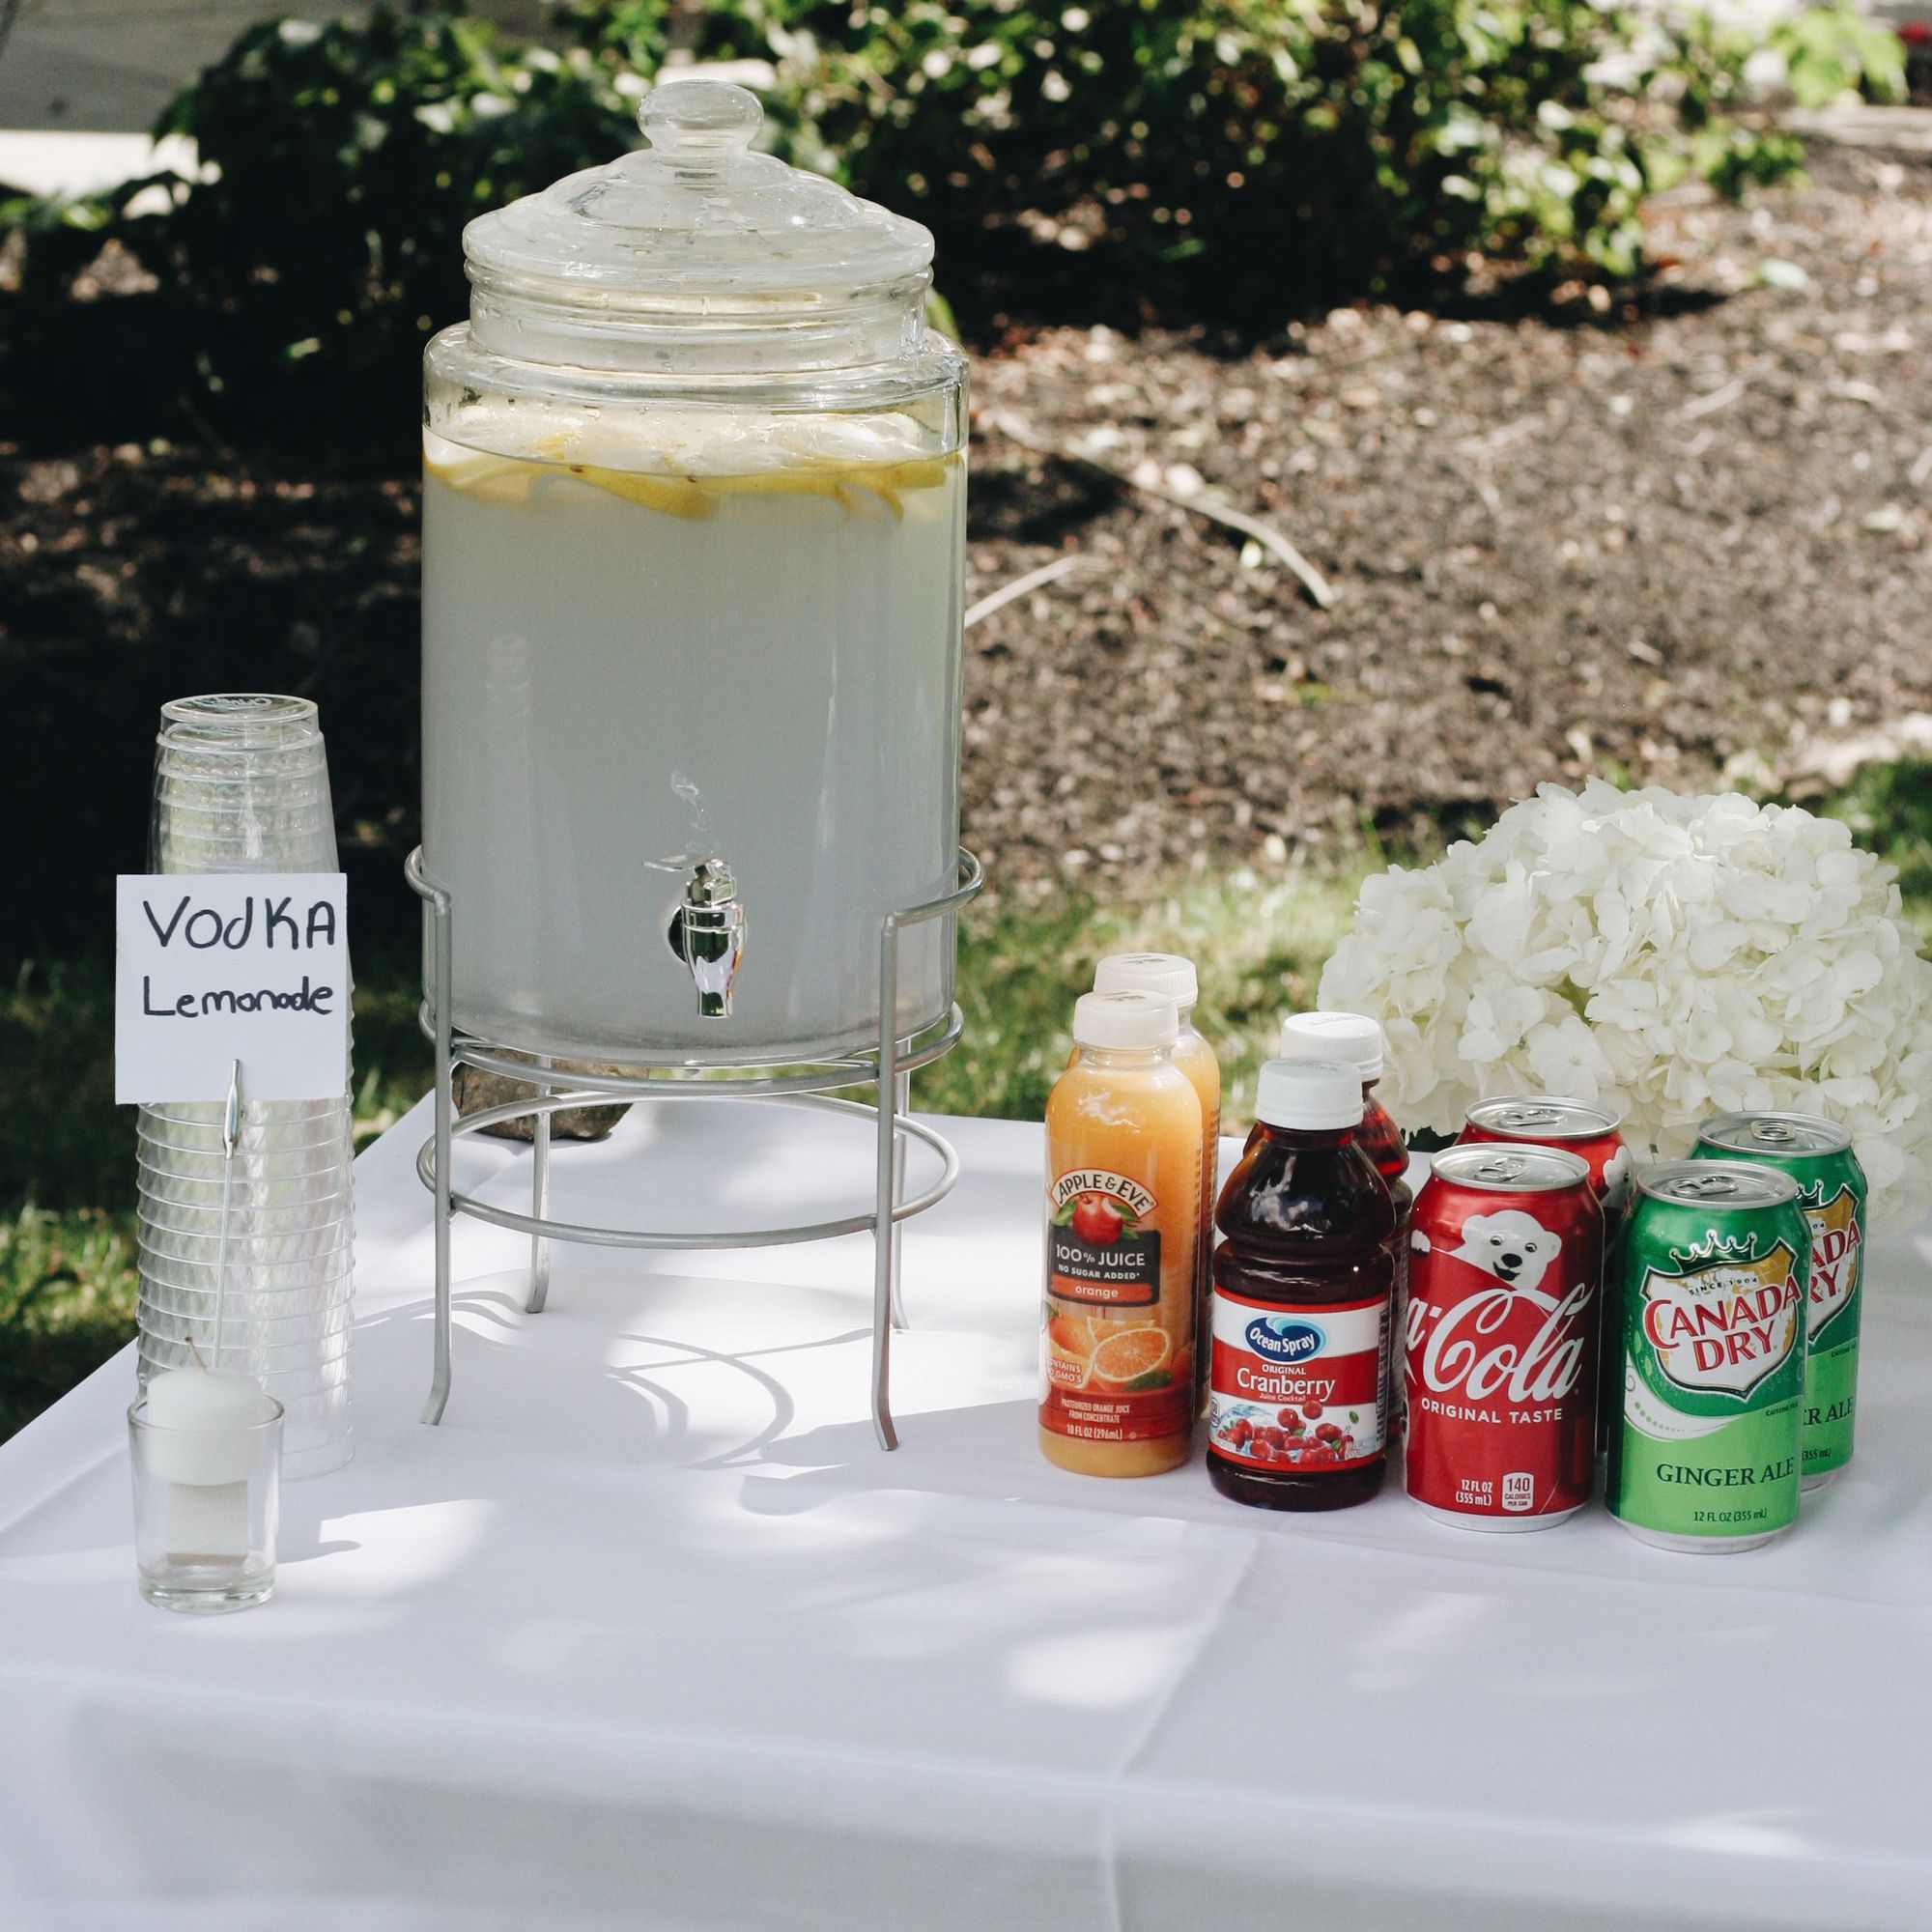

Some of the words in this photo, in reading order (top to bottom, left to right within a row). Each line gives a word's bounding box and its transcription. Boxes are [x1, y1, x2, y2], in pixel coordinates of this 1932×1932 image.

[1059, 1174, 1102, 1204] APPLE
[1104, 1177, 1117, 1190] &
[1116, 1179, 1150, 1211] EVE
[1056, 1243, 1095, 1263] 100%
[1097, 1252, 1146, 1266] JUICE
[1058, 1264, 1069, 1273] NO
[1070, 1266, 1101, 1279] SUGAR
[1074, 1285, 1119, 1300] orange
[1689, 1281, 1723, 1295] SINCE
[1644, 1275, 1803, 1350] CANADA
[1249, 1326, 1282, 1352] Ocean
[1282, 1333, 1315, 1356] Spray
[1692, 1320, 1776, 1372] DRY
[1048, 1357, 1082, 1374] NTAINS
[1262, 1363, 1307, 1376] ORIGINAL
[1236, 1367, 1336, 1403] Cranberry
[1259, 1392, 1276, 1402] Juice
[1277, 1394, 1306, 1403] Cocktail
[1115, 1405, 1130, 1414] JUICE
[1421, 1397, 1502, 1424] ORIGINAL
[1508, 1407, 1564, 1425] TASTE
[1825, 1395, 1853, 1424] ALE
[1066, 1424, 1074, 1435] 10
[1074, 1425, 1084, 1436] FL
[1083, 1427, 1094, 1438] OZ
[1656, 1463, 1756, 1488] GINGER
[1760, 1457, 1794, 1484] ALE
[1461, 1478, 1470, 1492] 12
[1470, 1479, 1482, 1492] FL
[1481, 1481, 1494, 1493] OZ
[1507, 1477, 1531, 1492] 140
[1455, 1491, 1475, 1505] (355
[1693, 1511, 1705, 1522] 12
[1707, 1511, 1718, 1522] FL
[1719, 1511, 1732, 1522] OZ
[1732, 1510, 1752, 1523] (355
